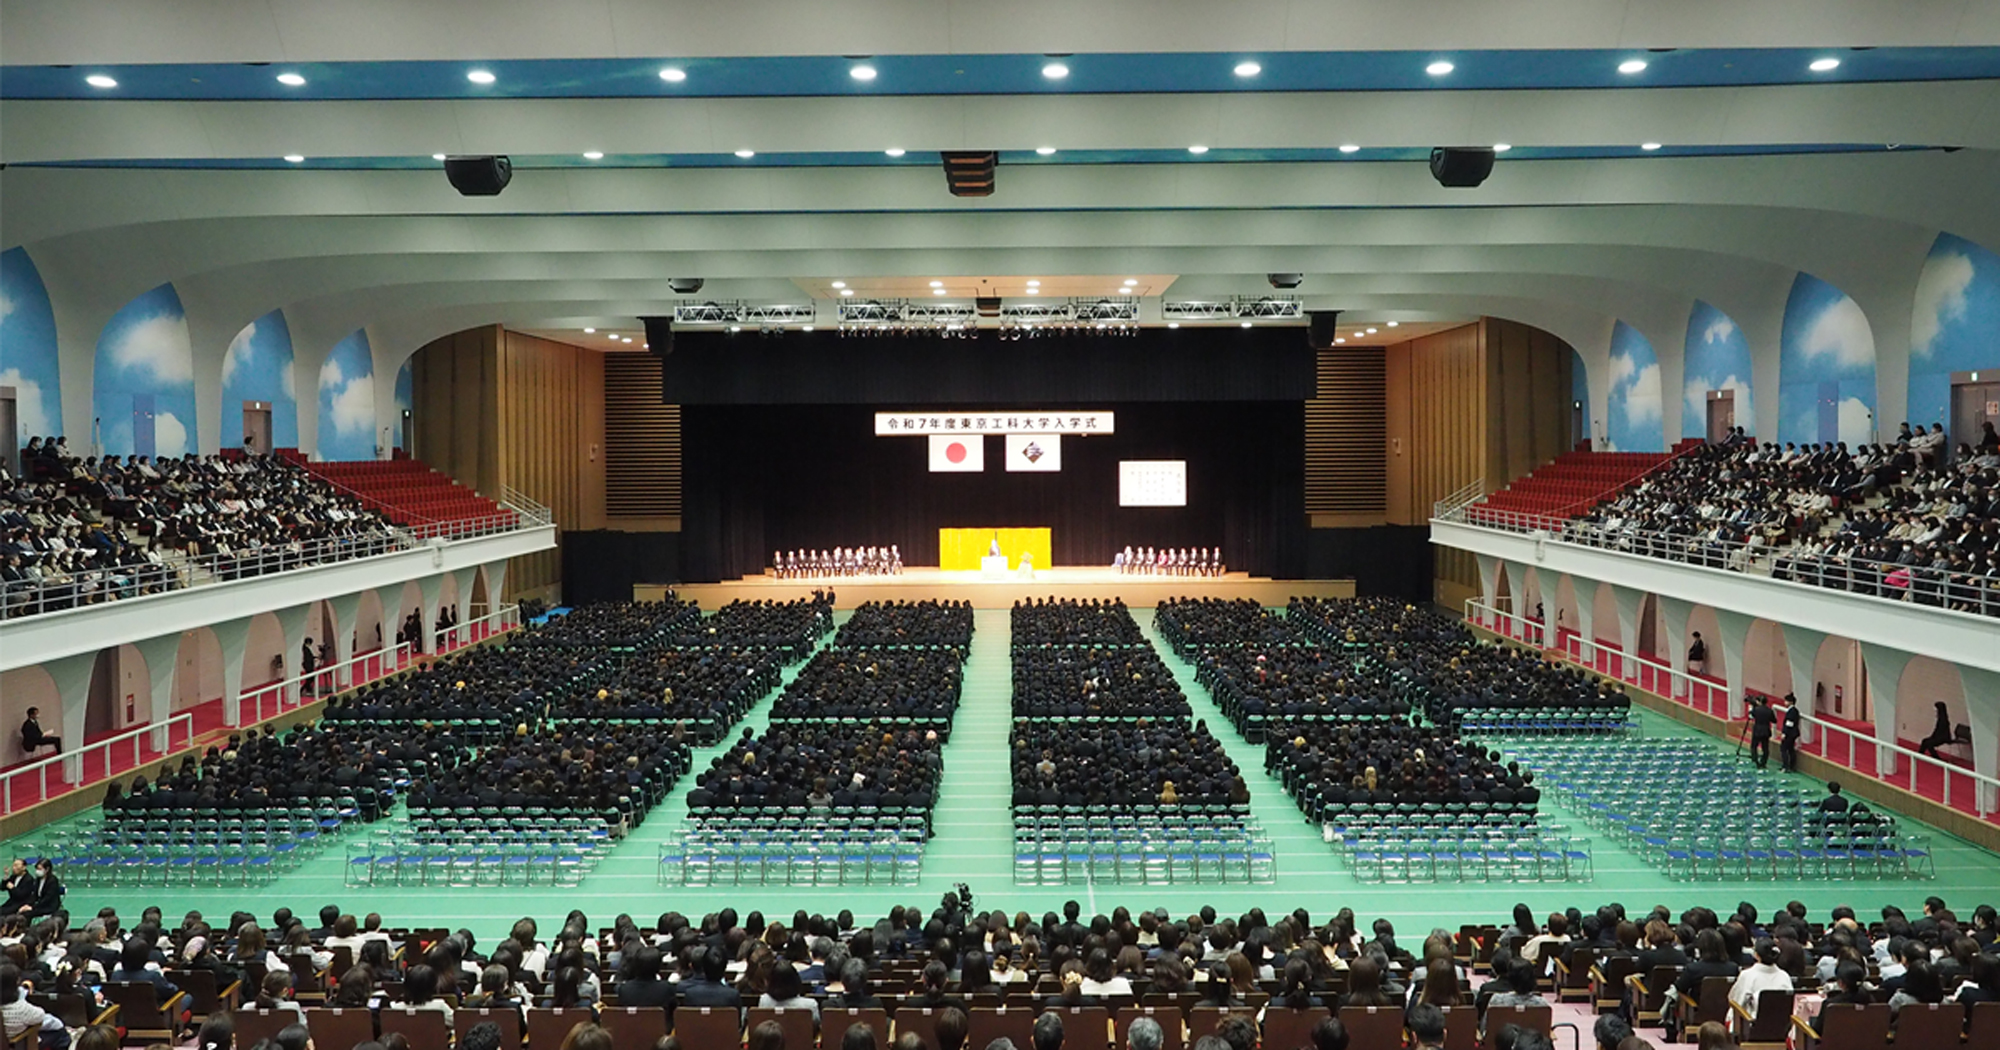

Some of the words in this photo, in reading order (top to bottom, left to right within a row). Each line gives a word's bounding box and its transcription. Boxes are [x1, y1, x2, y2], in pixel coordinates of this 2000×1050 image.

[887, 416, 1098, 430] 令和7年度東京工科大学入学式
